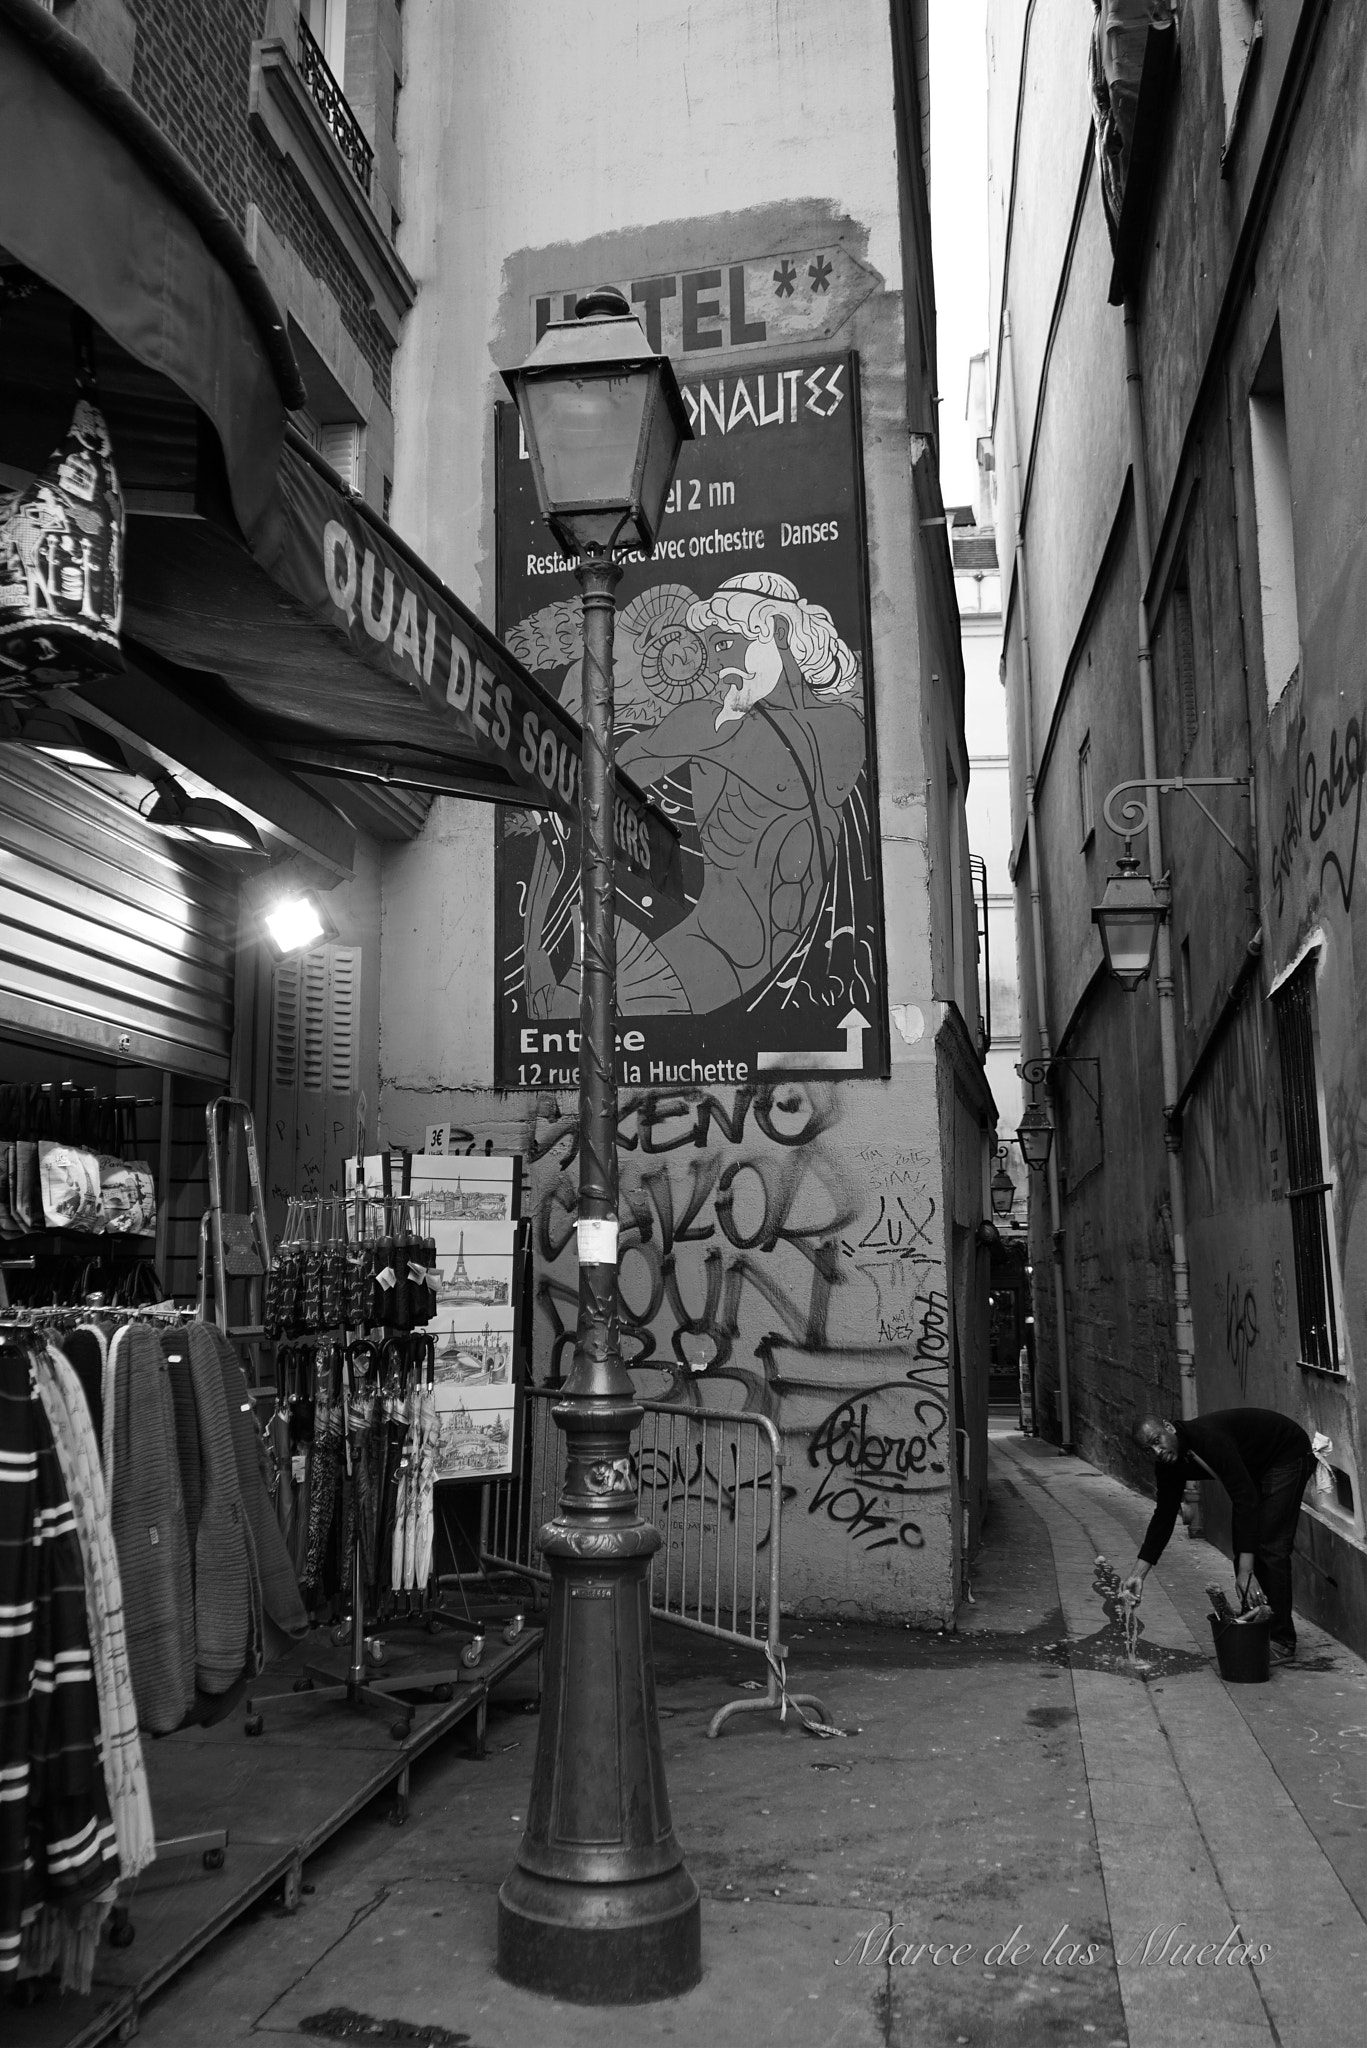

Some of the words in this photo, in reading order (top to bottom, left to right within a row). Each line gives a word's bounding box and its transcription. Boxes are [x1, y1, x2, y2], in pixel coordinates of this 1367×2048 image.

[687, 479, 702, 510] 2
[651, 538, 685, 561] avec
[688, 529, 765, 557] orchestre
[780, 520, 839, 548] Danses
[323, 520, 437, 686] QUAI
[446, 636, 513, 751] DES
[519, 711, 650, 870] SOUIRS
[518, 1064, 542, 1086] 12
[549, 1066, 581, 1085] rue
[623, 1060, 641, 1084] la
[649, 1058, 749, 1083] Huchette
